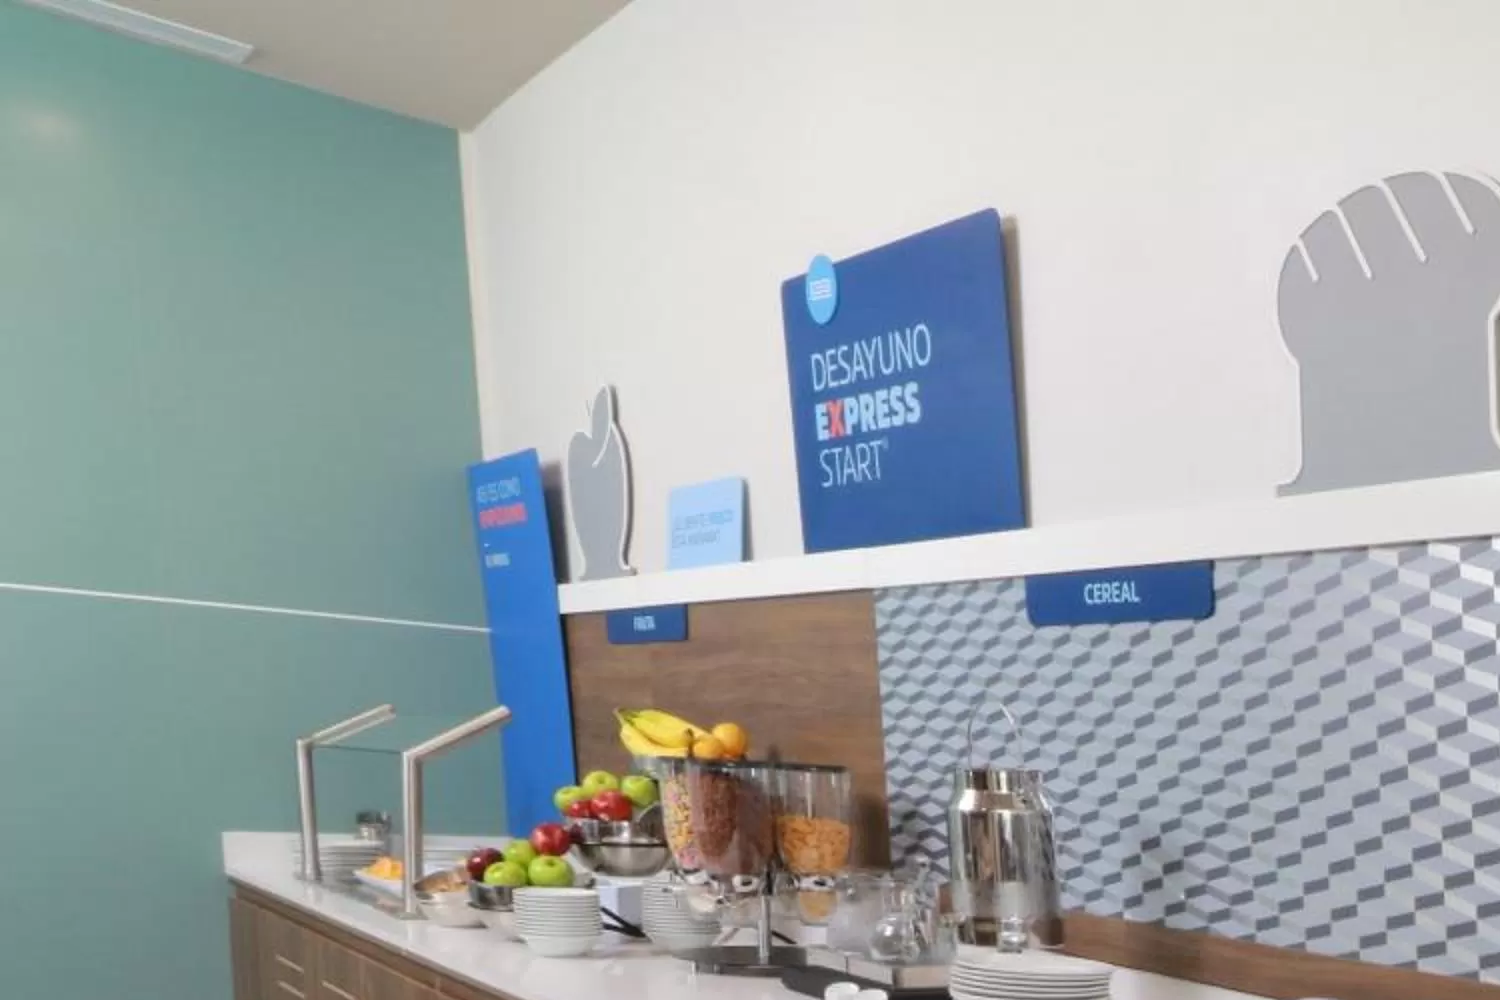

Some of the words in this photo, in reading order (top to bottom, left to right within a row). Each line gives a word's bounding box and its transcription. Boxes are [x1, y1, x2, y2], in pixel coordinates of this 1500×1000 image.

[810, 323, 931, 392] DESAYUNO
[815, 382, 921, 442] EXPRESS
[1083, 581, 1141, 605] CEREAL
